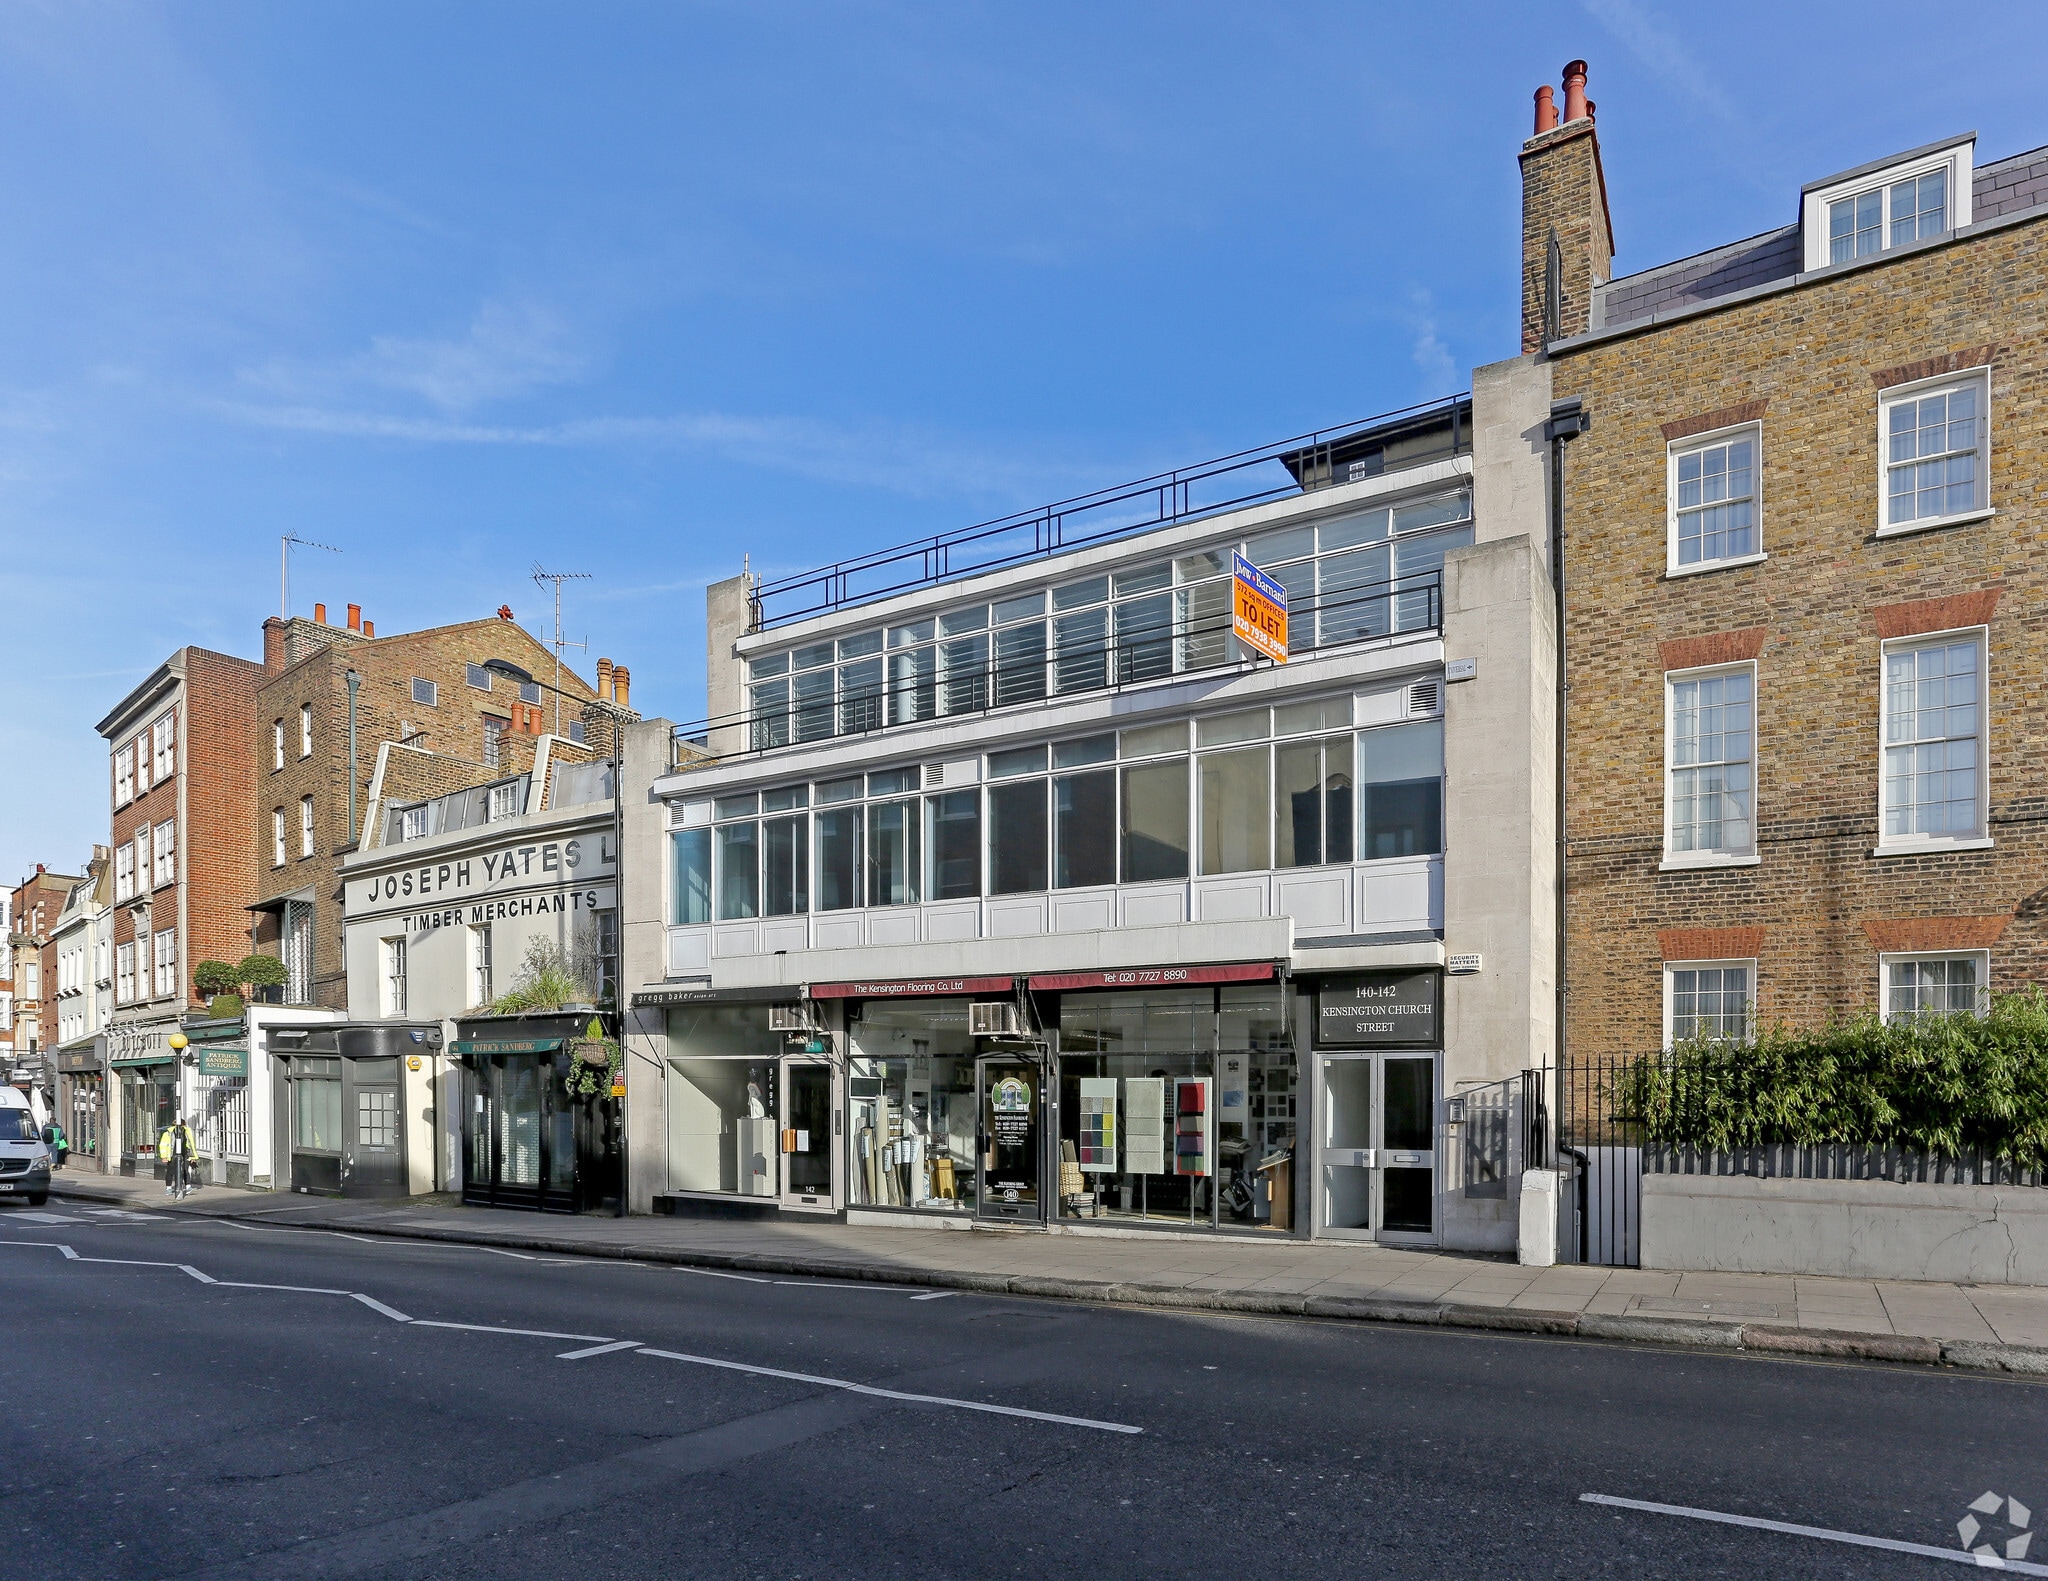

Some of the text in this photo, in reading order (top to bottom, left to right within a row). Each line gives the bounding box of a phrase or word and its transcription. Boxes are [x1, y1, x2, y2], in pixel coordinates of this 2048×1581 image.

[1255, 572, 1285, 605] Barnard
[1237, 582, 1248, 596] 572
[1262, 599, 1285, 621] OFFICES
[1241, 599, 1281, 638] TO LET
[1235, 615, 1286, 657] 020 7938 3990
[368, 860, 470, 903] JOSEPH
[482, 840, 581, 882] YATES
[402, 890, 597, 932] TIMBER MERCHANTS
[1119, 972, 1136, 982] 020
[1138, 971, 1161, 982] 7727
[1163, 969, 1187, 980] 8890
[854, 984, 867, 993] The
[869, 983, 905, 995] Kensington
[907, 982, 935, 992] Flooring
[950, 981, 963, 990] Ltd
[1355, 985, 1396, 999] 140-142
[637, 994, 663, 1003] gregg
[668, 991, 693, 1000] baker
[1322, 1004, 1432, 1017] KENSINGTON CHURCH
[1356, 1022, 1395, 1033] STREET
[501, 1042, 535, 1051] SANDBERG
